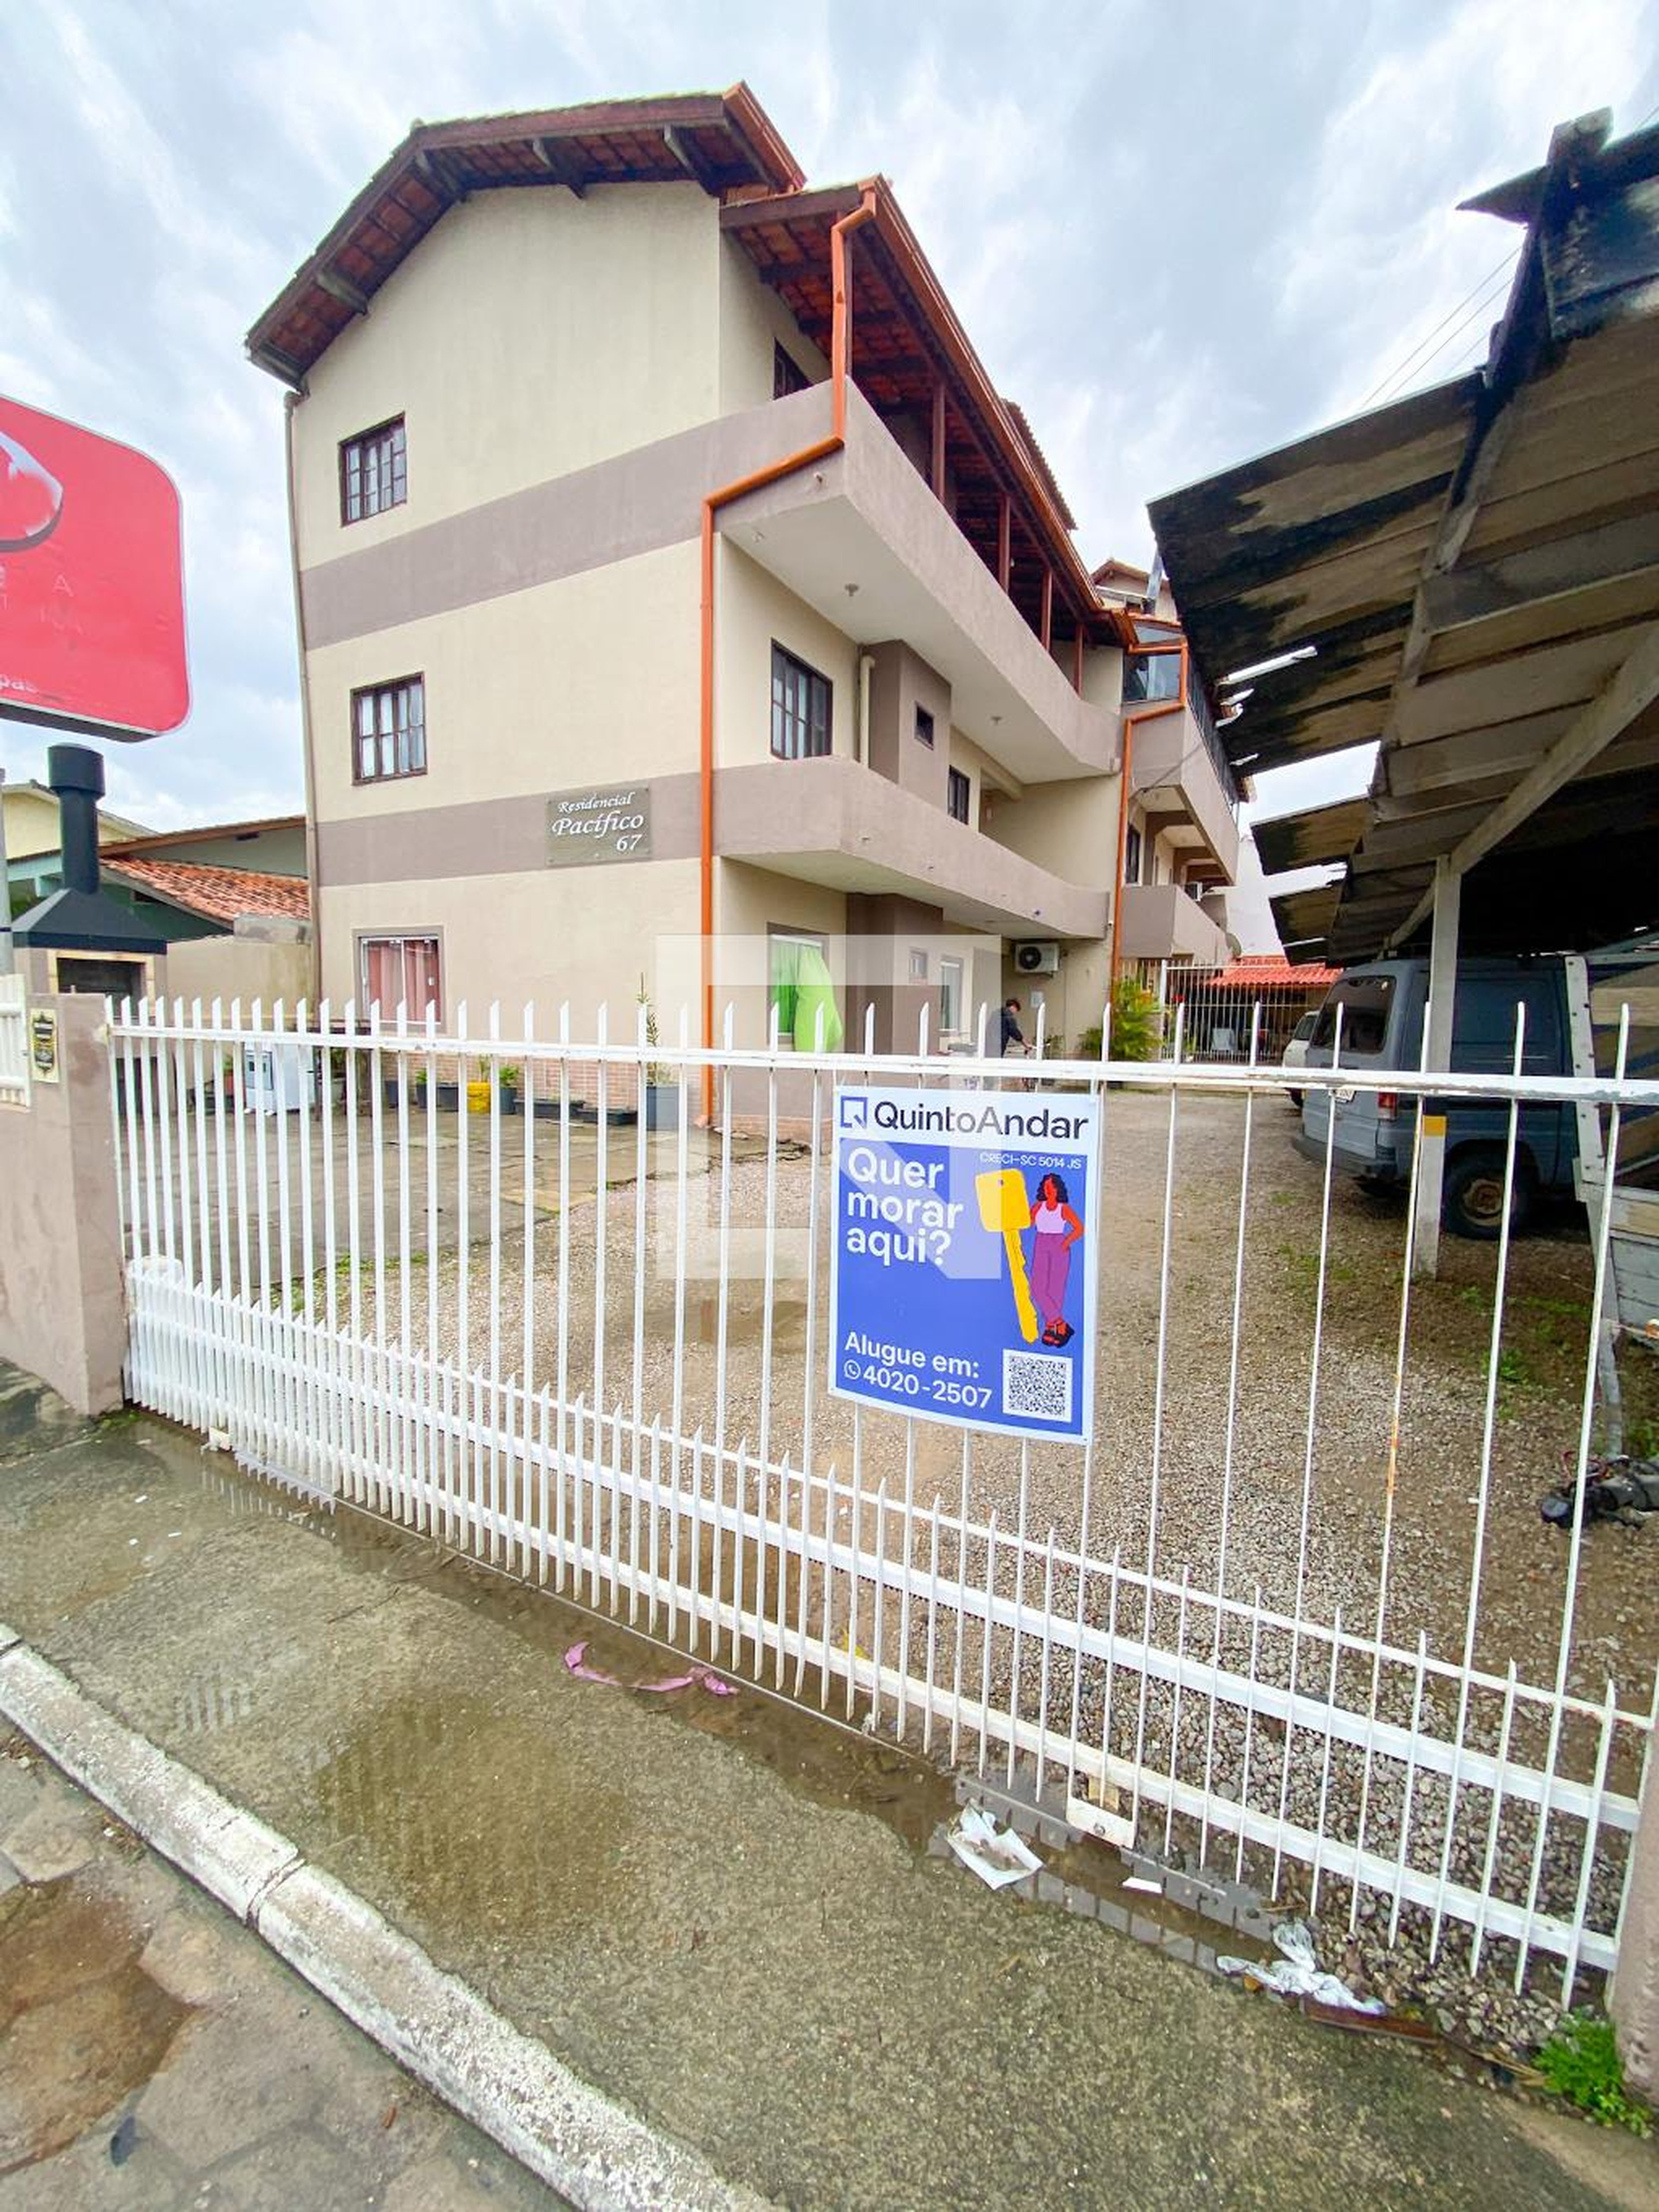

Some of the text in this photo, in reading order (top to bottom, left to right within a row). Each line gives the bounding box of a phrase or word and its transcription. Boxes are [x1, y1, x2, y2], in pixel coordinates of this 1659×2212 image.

[558, 792, 636, 814] Residencial
[552, 810, 644, 838] Pacífico
[617, 834, 642, 851] 67
[874, 1100, 1089, 1139] QuintoAndar
[848, 1146, 944, 1189] Quer
[979, 1152, 1036, 1166] CRECI-SC
[847, 1191, 964, 1229] morar
[846, 1227, 951, 1266] aqui?
[844, 1332, 979, 1378] Alugue em:
[863, 1365, 993, 1409] 4020-2507
